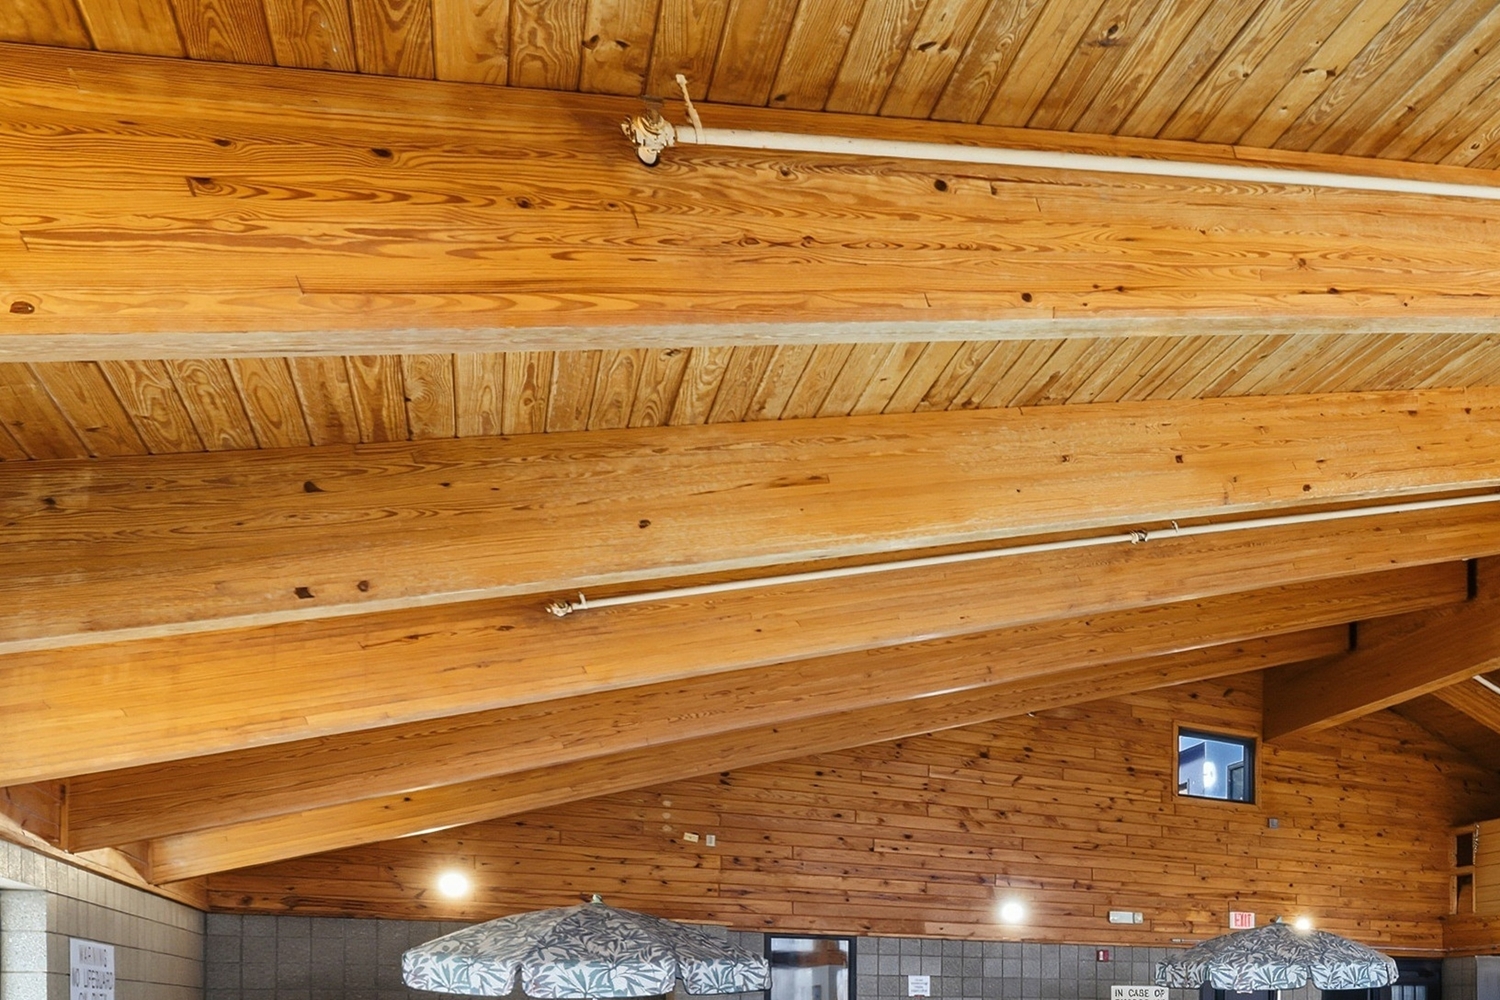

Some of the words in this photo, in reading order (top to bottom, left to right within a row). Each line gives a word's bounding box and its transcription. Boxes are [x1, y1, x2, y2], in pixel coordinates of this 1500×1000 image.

[1234, 913, 1252, 927] EXIT
[79, 945, 108, 968] WARNING
[83, 969, 114, 991] LIFEGUARD
[1114, 989, 1123, 997] IN
[1128, 988, 1150, 997] CASE
[1153, 989, 1166, 997] OF
